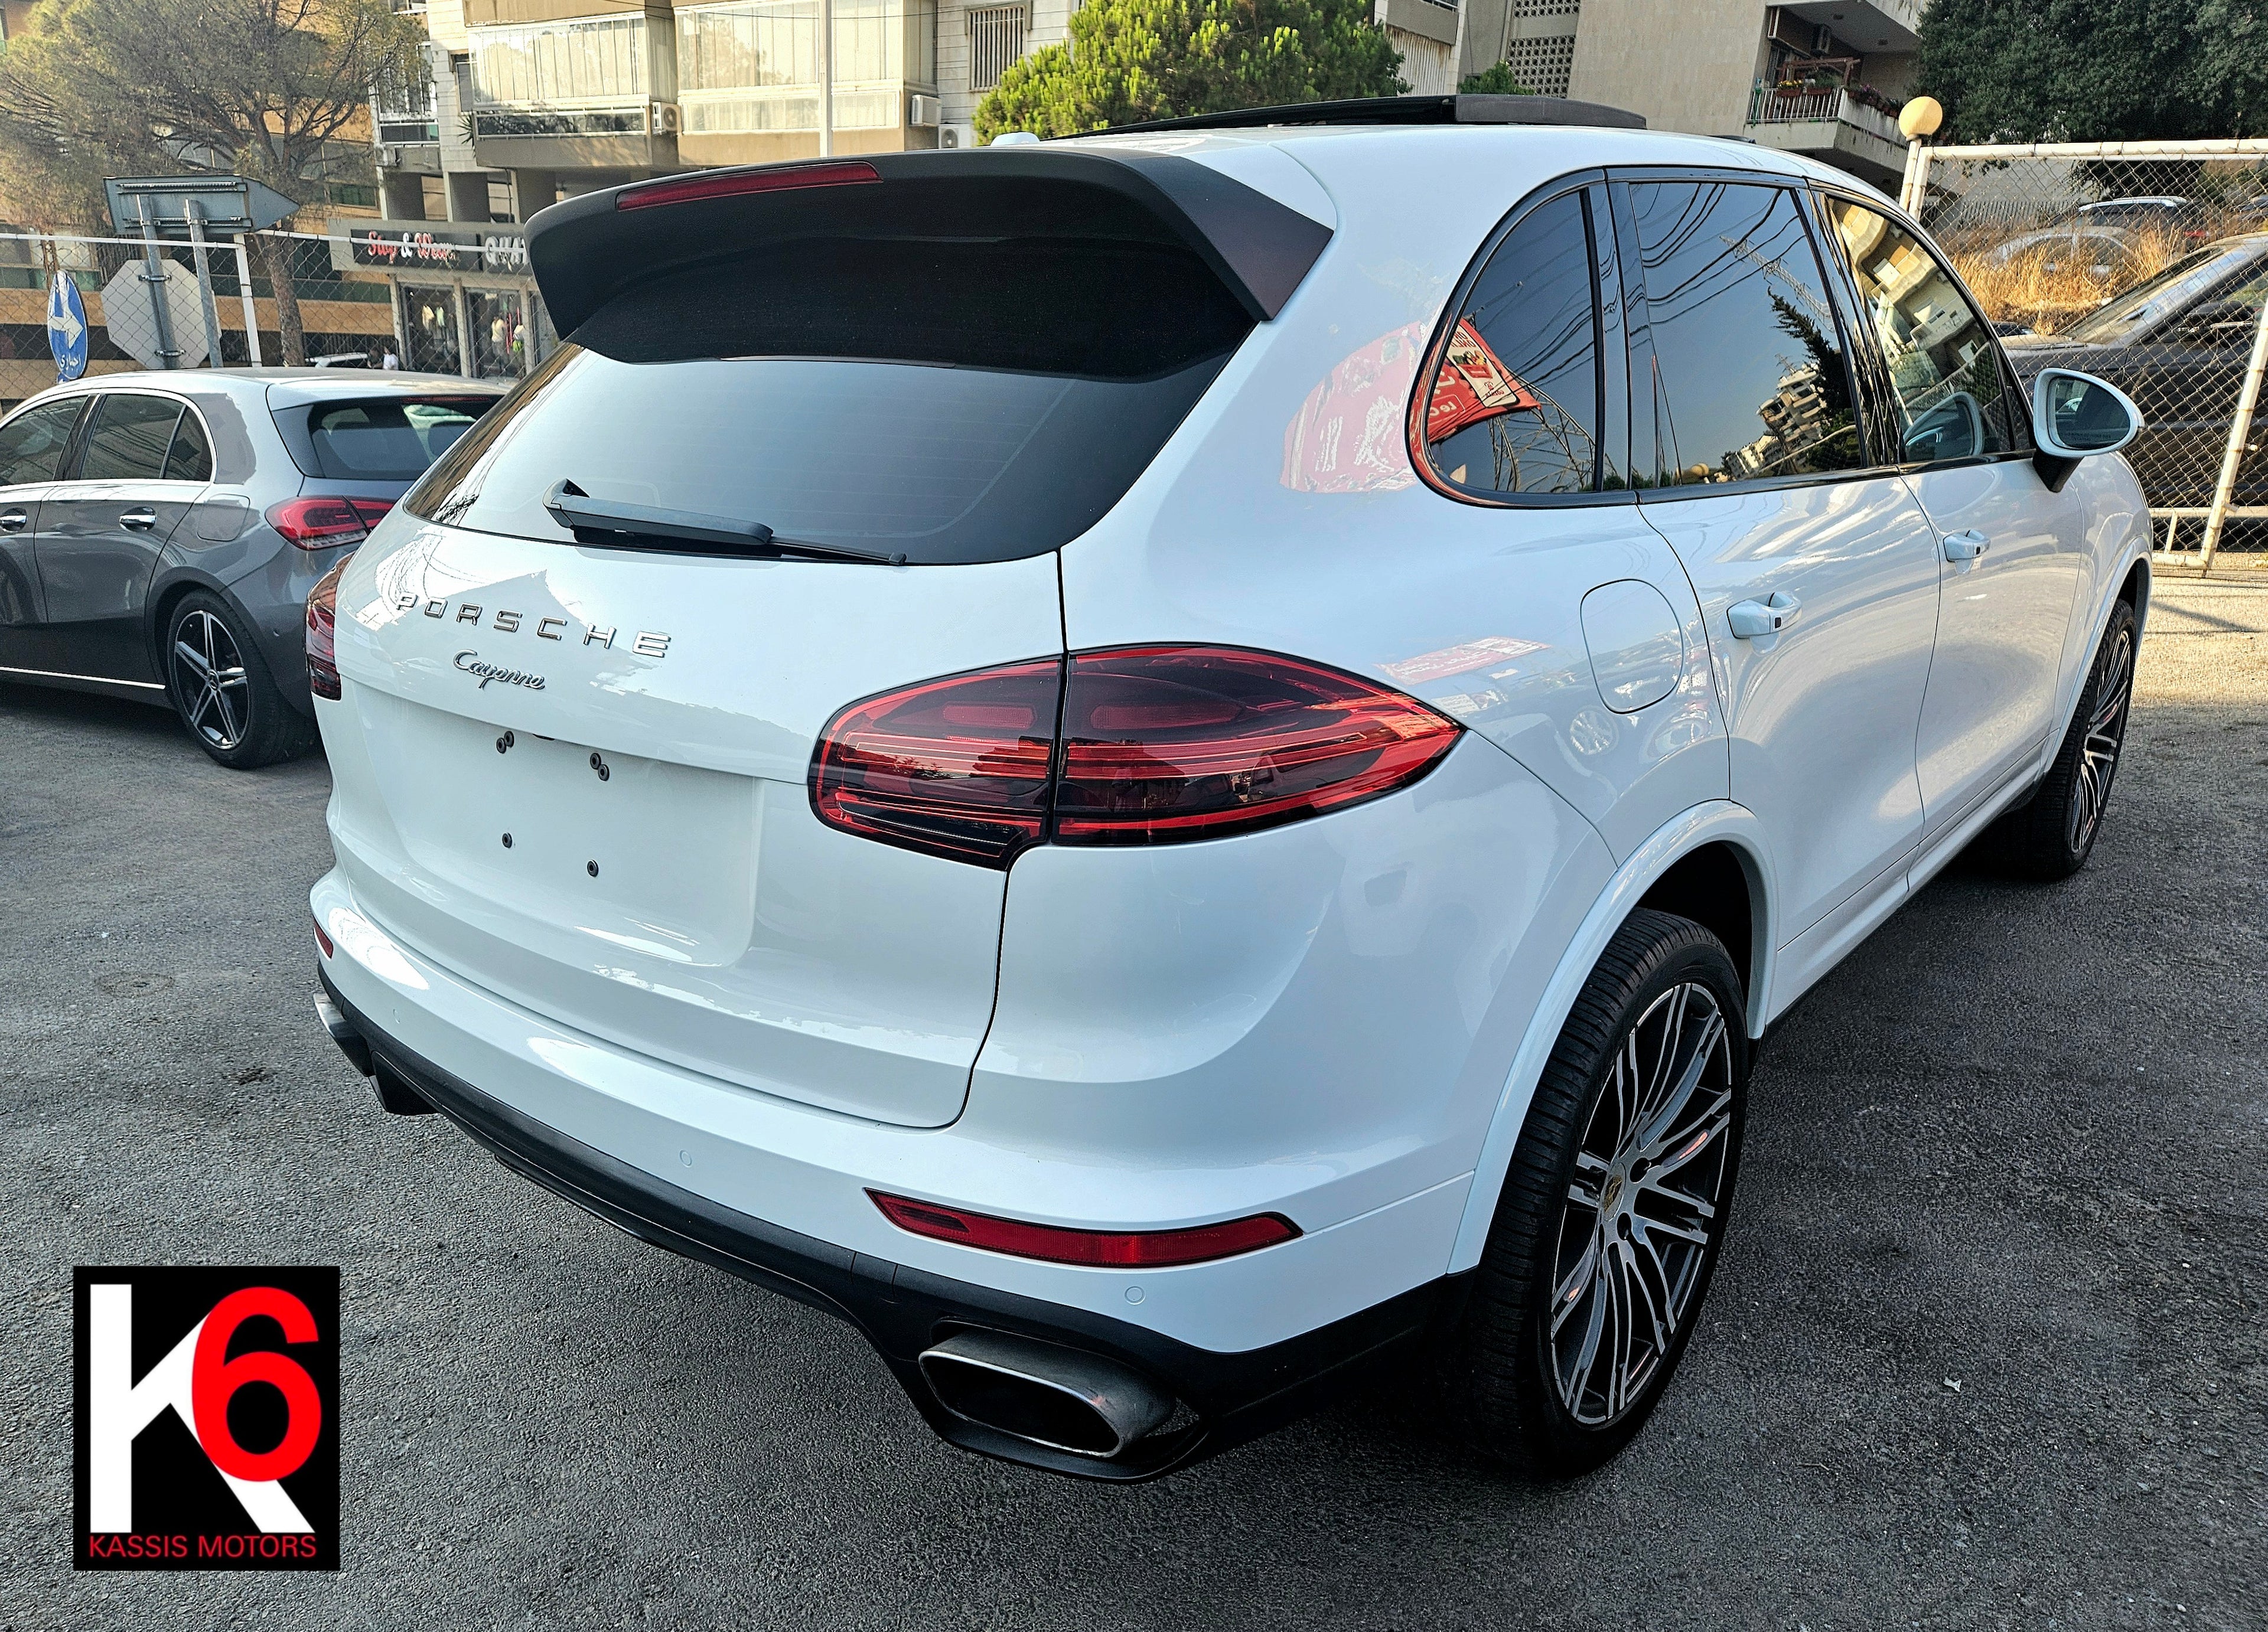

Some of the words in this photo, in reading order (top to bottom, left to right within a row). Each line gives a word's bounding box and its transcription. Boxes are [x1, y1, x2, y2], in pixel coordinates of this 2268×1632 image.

[400, 232, 413, 258] &
[396, 591, 671, 658] PORSCHE
[452, 649, 545, 691] Cayenne
